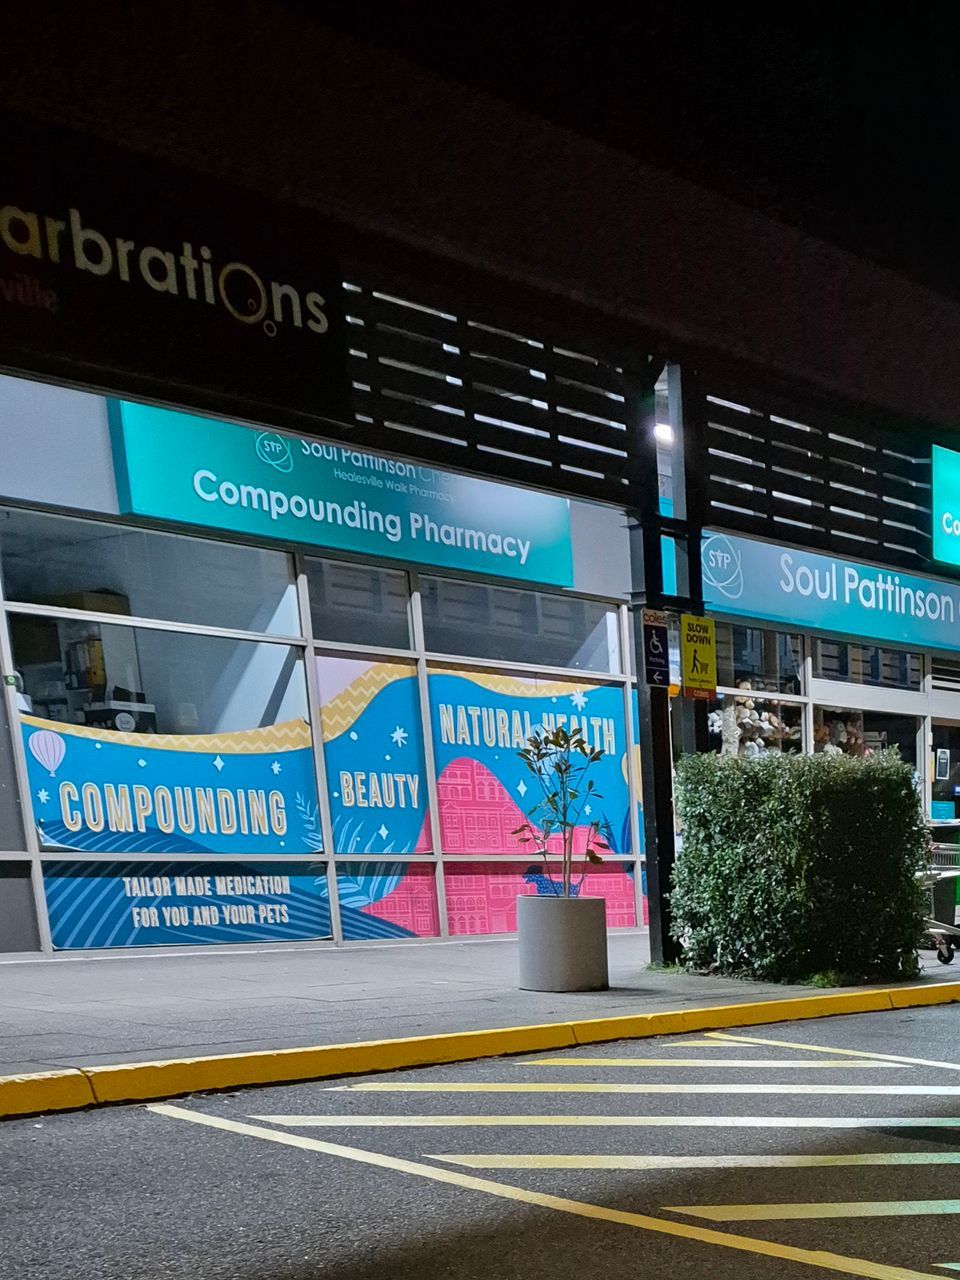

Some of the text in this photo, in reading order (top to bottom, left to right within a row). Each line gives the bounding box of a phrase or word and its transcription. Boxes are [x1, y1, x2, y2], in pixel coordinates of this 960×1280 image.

[333, 467, 384, 489] Healesville
[385, 478, 408, 495] Walk
[193, 469, 531, 566] Compounding Pharmacy
[779, 553, 837, 601] Soul
[844, 566, 954, 623] Pattinson
[686, 633, 711, 646] DOWN
[687, 622, 709, 635] SLOW
[438, 703, 531, 750] NATURAL
[339, 770, 420, 809] BEAUTY
[58, 781, 288, 837] COMPOUNDING
[122, 875, 292, 898] TAILOR MADE MEDICATION
[132, 903, 290, 929] FOR YOU AND YOUR PETS
